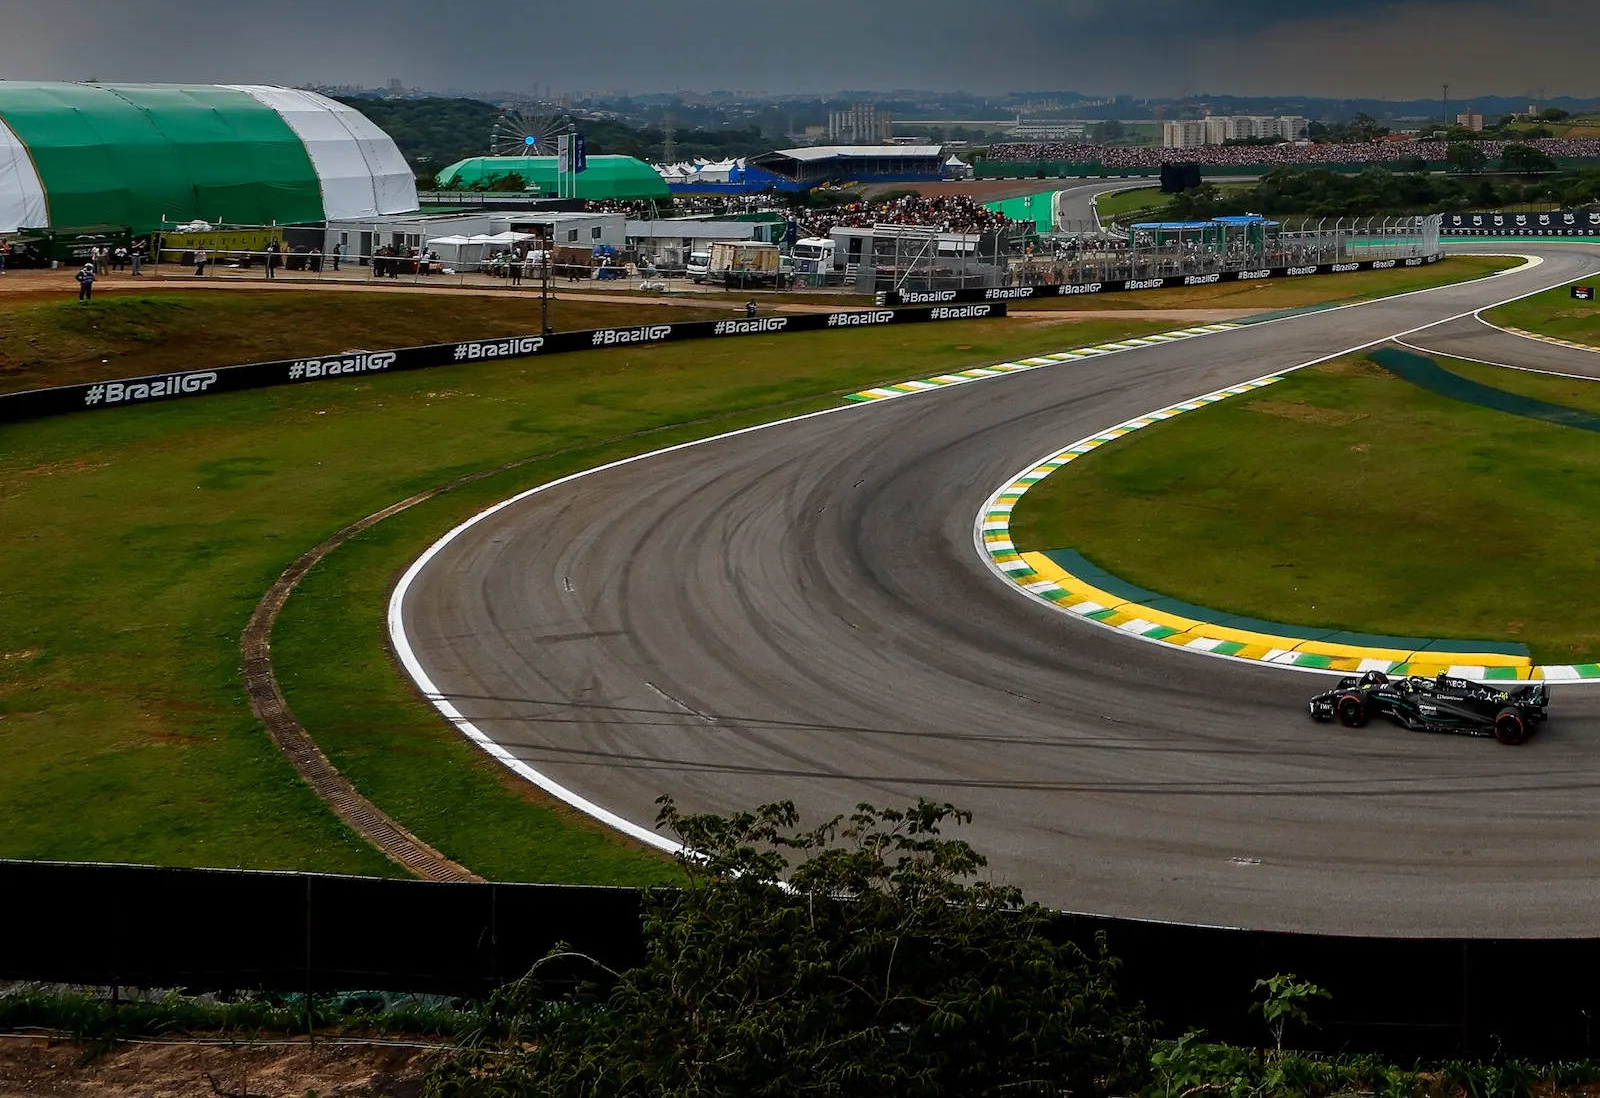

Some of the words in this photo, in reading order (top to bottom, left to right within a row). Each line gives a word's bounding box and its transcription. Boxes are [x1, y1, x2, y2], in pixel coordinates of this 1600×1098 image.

[1238, 269, 1271, 280] #BrazilGP
[1287, 265, 1317, 276] #BrazilGP
[1125, 279, 1164, 290] #BrazilGP
[1184, 273, 1220, 285] #BrazilGP
[985, 287, 1034, 299] #BrazilGP
[1058, 283, 1102, 295] #BrazilGP
[902, 290, 957, 303] #BrazilGP
[828, 311, 894, 326] #BrazilGP
[931, 305, 991, 319] #BrazilGP
[714, 318, 787, 335] #BrazilGP
[592, 325, 672, 345] #BrazilGP
[454, 337, 544, 360] #BrazilGP
[288, 352, 398, 380] #BrazilGP
[85, 372, 218, 405] #BrazilGP
